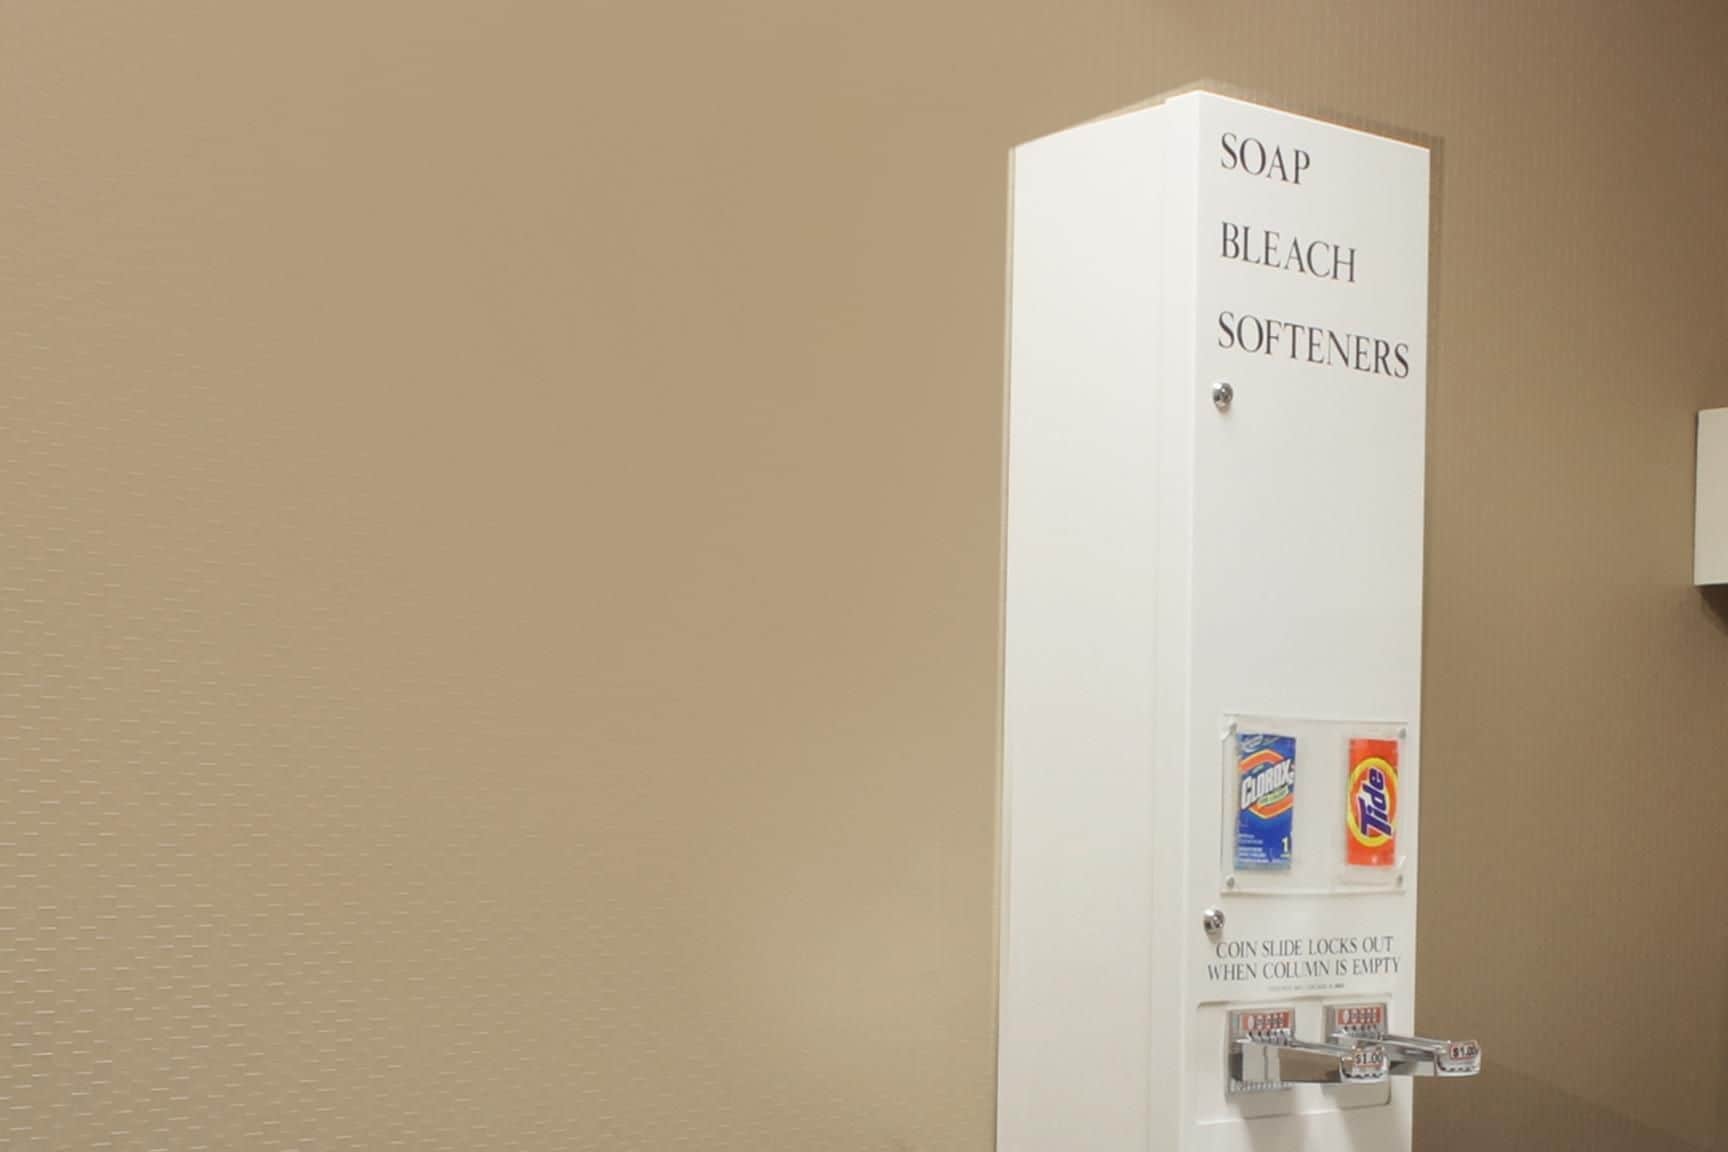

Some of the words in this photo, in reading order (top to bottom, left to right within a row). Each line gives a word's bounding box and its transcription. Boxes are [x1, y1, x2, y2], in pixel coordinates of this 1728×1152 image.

[1220, 132, 1310, 185] SOAP
[1220, 221, 1356, 283] BLEACH
[1217, 311, 1409, 378] SOFTENERS
[1358, 768, 1392, 836] Tide
[1208, 962, 1258, 981] WHEN
[1262, 959, 1330, 979] COLUMN
[1335, 959, 1348, 976] IS
[1352, 956, 1401, 976] EMPTY
[1216, 940, 1258, 959] COIN
[1262, 939, 1303, 958] SLIDE
[1308, 937, 1358, 956] LOCKS
[1362, 935, 1395, 953] OUT
